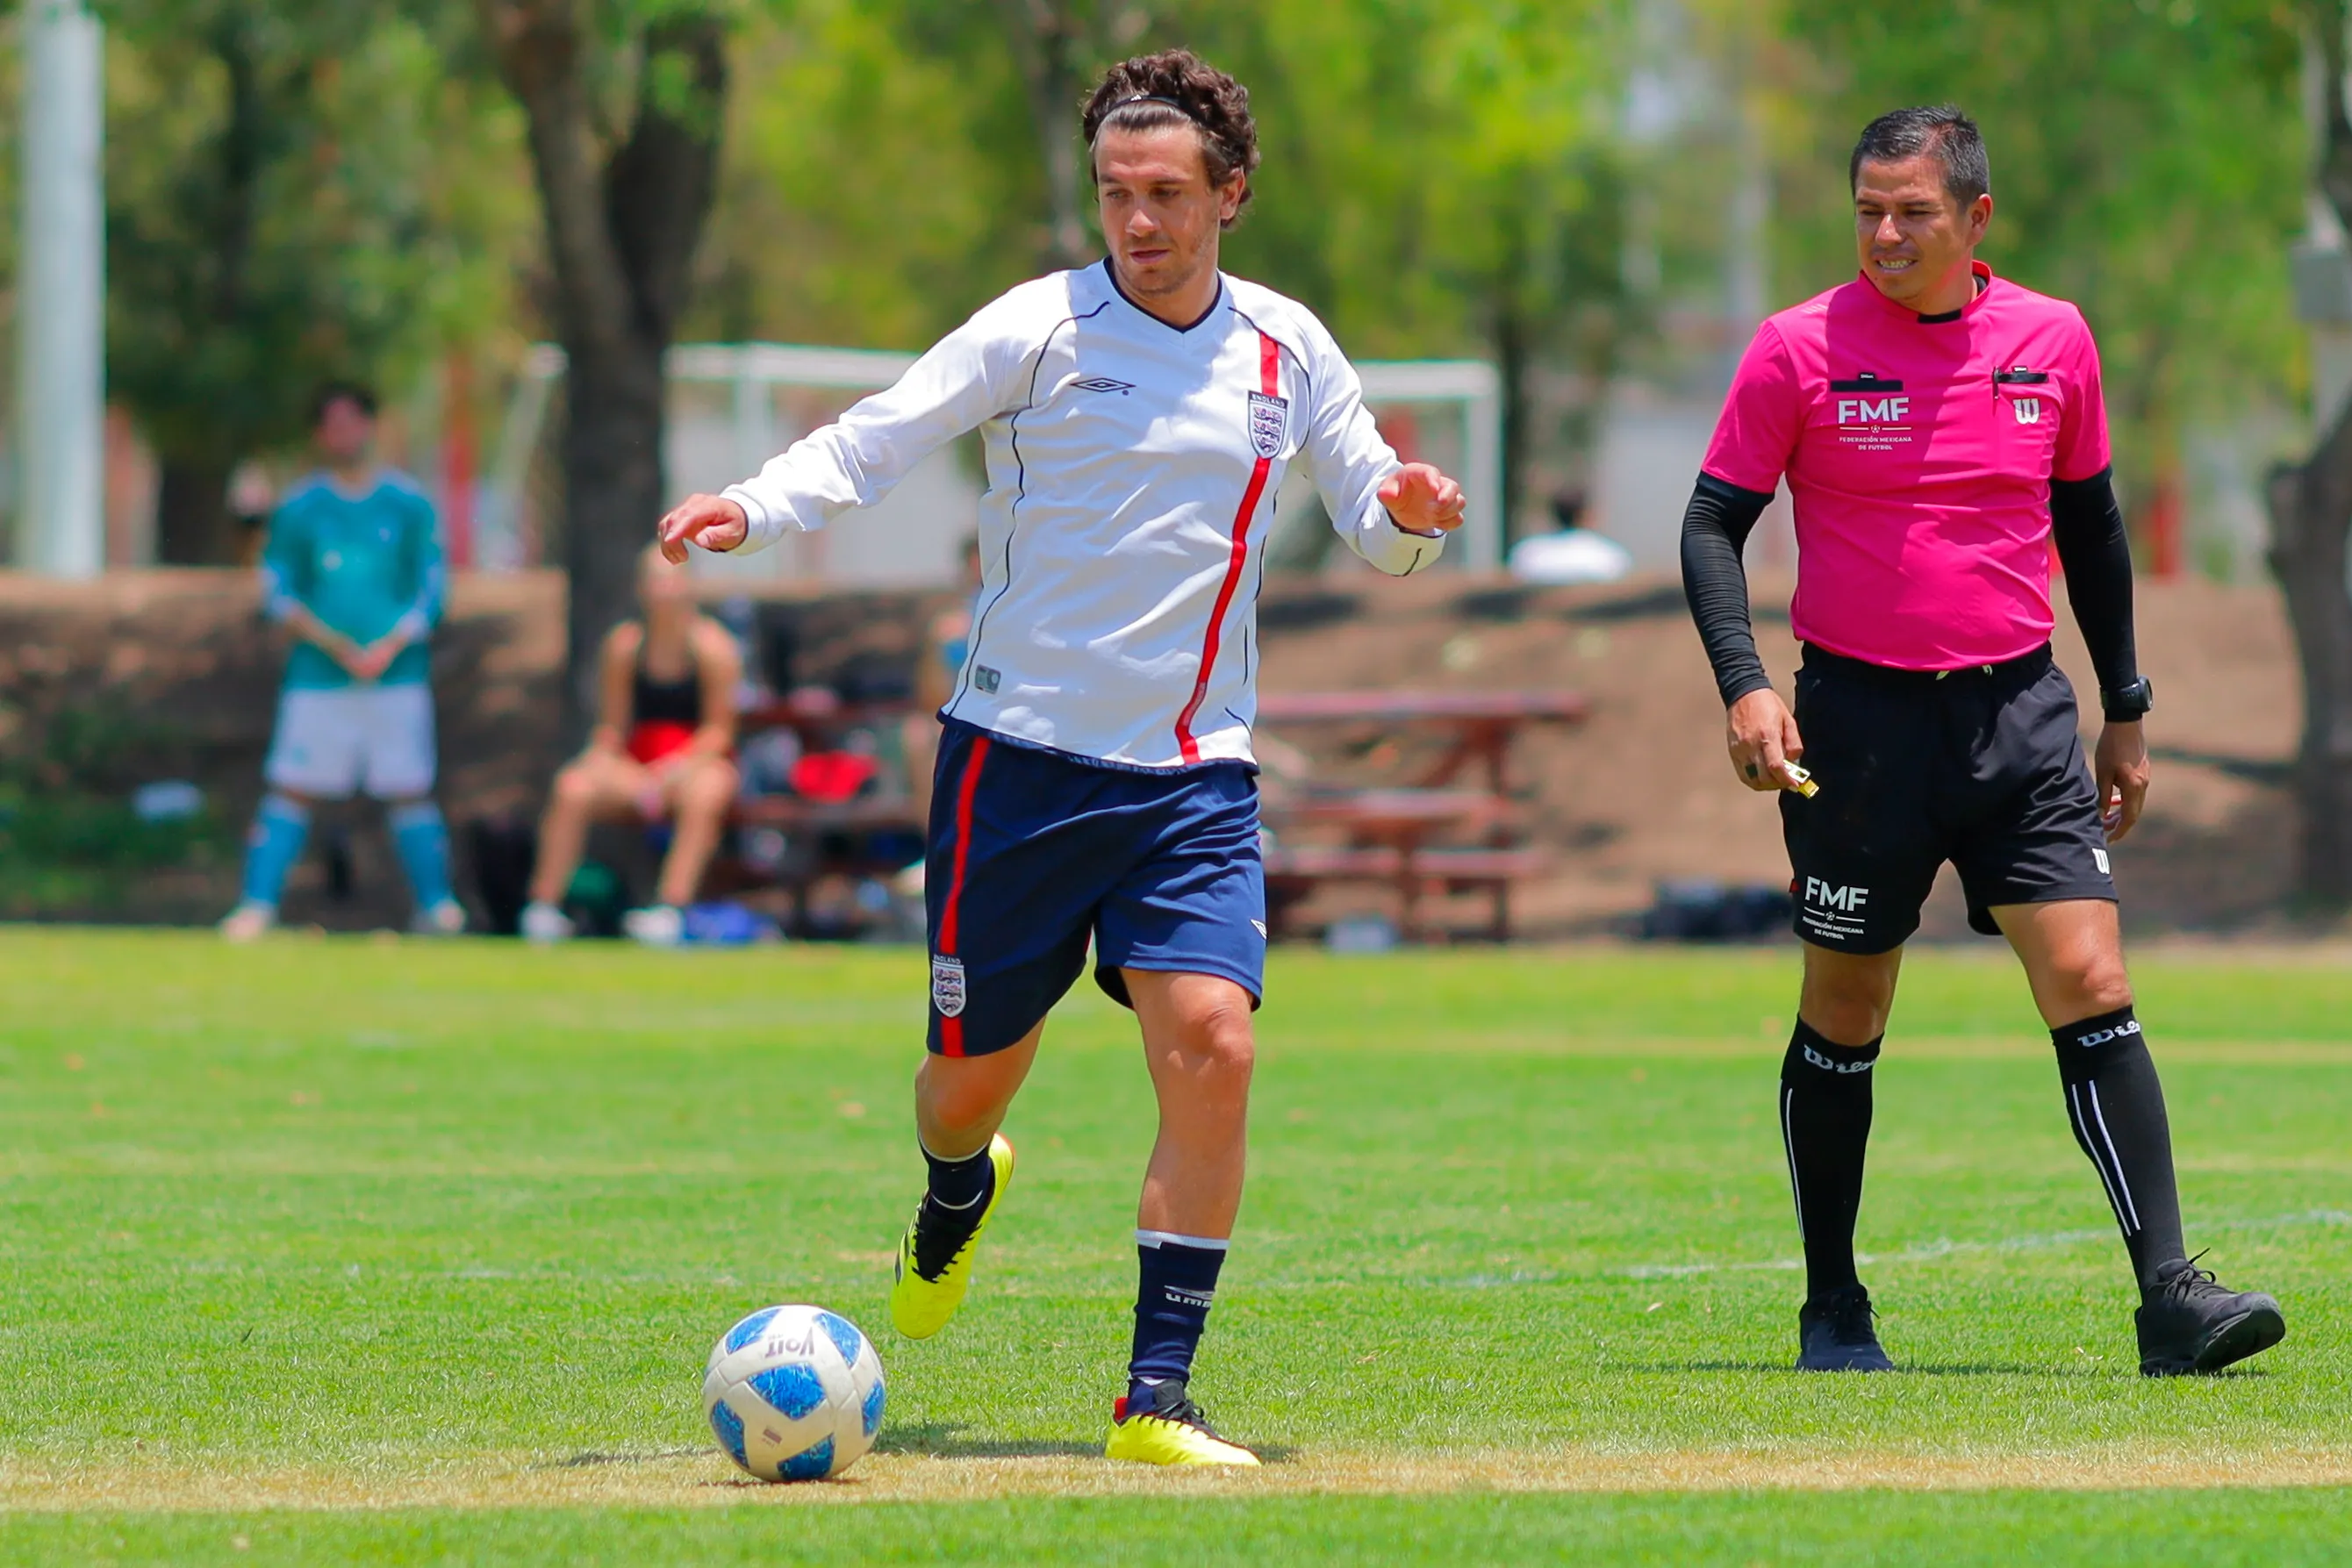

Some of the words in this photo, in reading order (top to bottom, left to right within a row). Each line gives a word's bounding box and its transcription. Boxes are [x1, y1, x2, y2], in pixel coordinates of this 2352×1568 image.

[1251, 392, 1286, 408] ENGLAND
[1838, 397, 1910, 425] FMF
[1804, 876, 1869, 912] FMF
[1832, 925, 1864, 934] MEXICANA
[933, 954, 961, 964] ENGLAND
